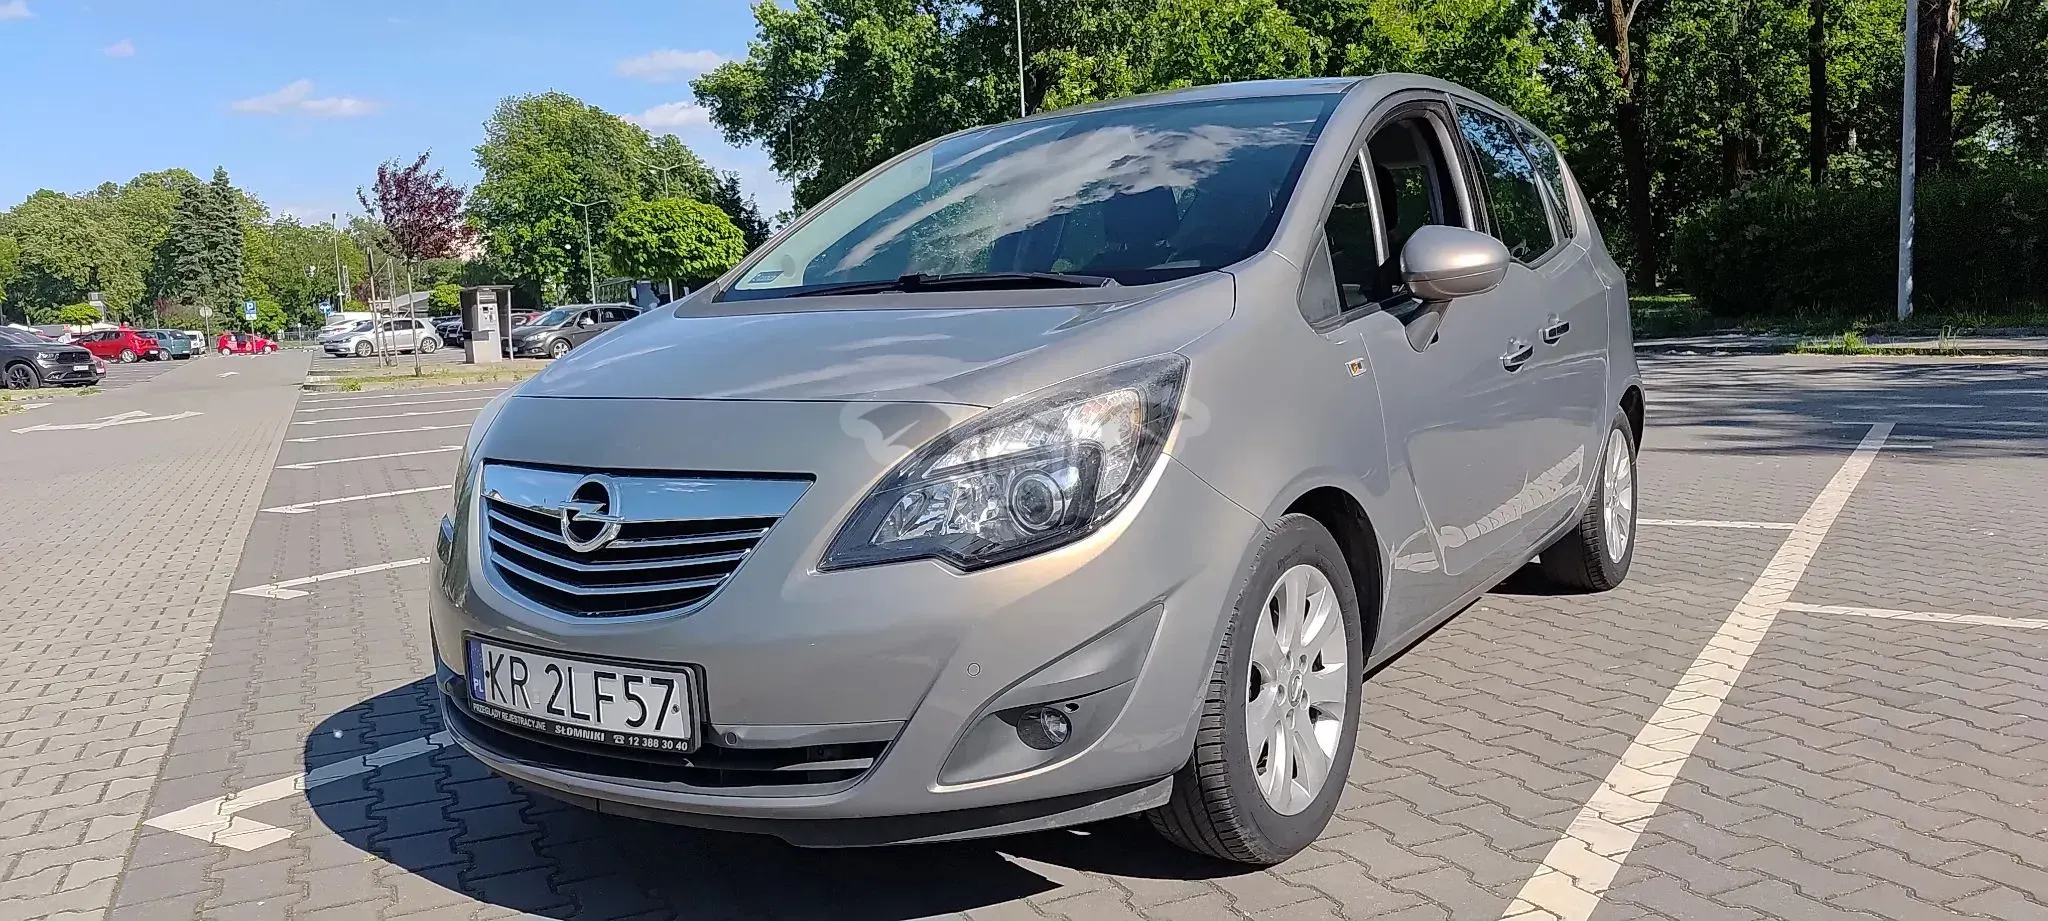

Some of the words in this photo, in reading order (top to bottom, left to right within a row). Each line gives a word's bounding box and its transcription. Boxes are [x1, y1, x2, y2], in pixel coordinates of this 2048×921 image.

[246, 302, 254, 311] P
[473, 677, 484, 692] PL
[488, 650, 531, 709] KR
[544, 663, 676, 732] 2LF57
[502, 711, 547, 731] REJESTRACYJNE
[555, 724, 605, 741] SŁOMNIKI
[628, 736, 640, 746] 12
[642, 738, 659, 748] 388
[662, 740, 673, 750] 30
[675, 741, 688, 751] 40
